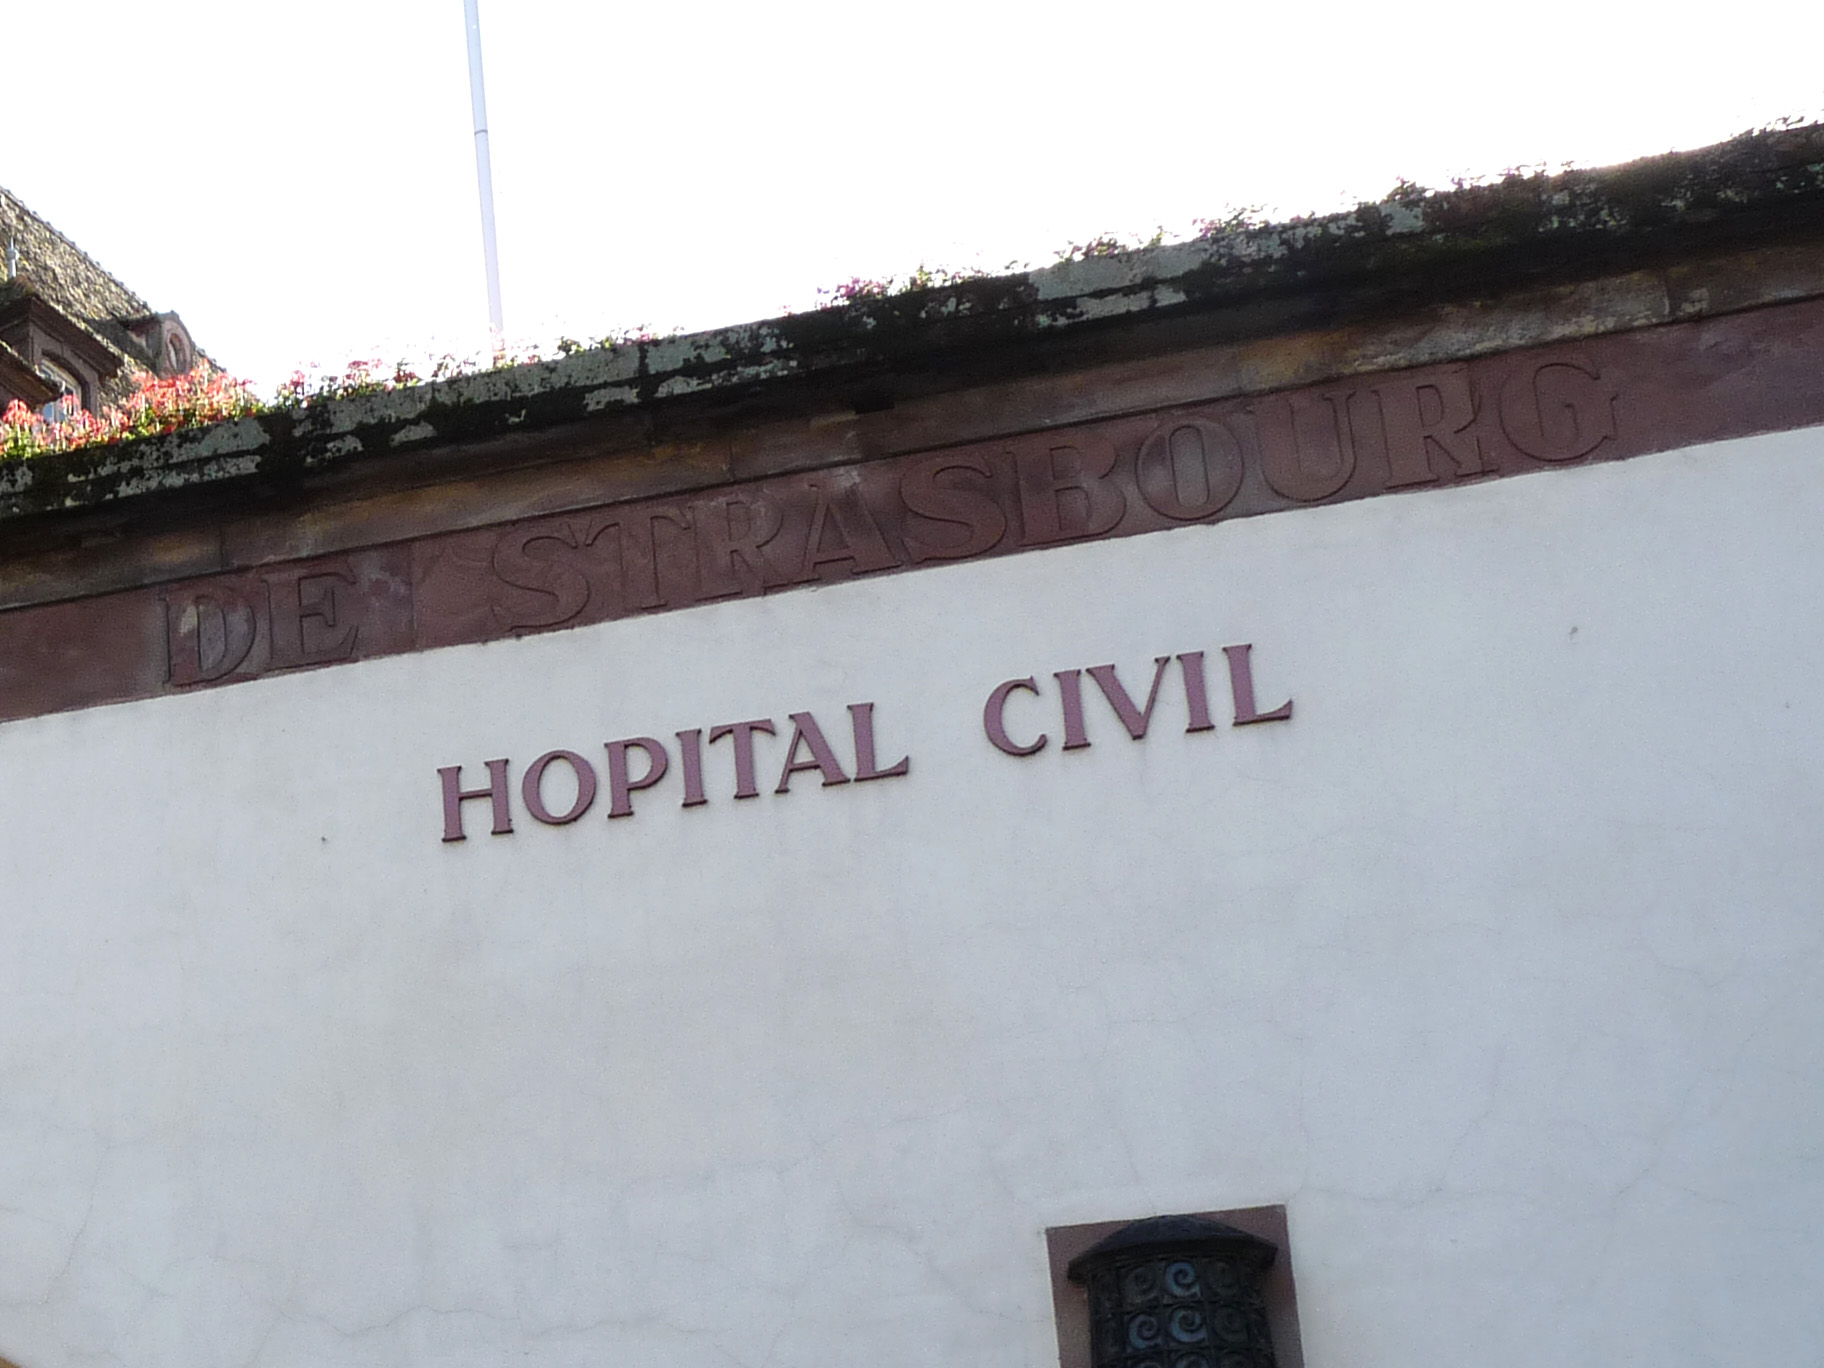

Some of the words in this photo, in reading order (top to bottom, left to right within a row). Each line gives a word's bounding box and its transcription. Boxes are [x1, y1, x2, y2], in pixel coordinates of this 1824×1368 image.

[162, 564, 360, 687] DE
[489, 361, 1619, 631] STRASBOURG
[437, 702, 910, 842] HOPITAL
[983, 643, 1295, 757] CIVIL
